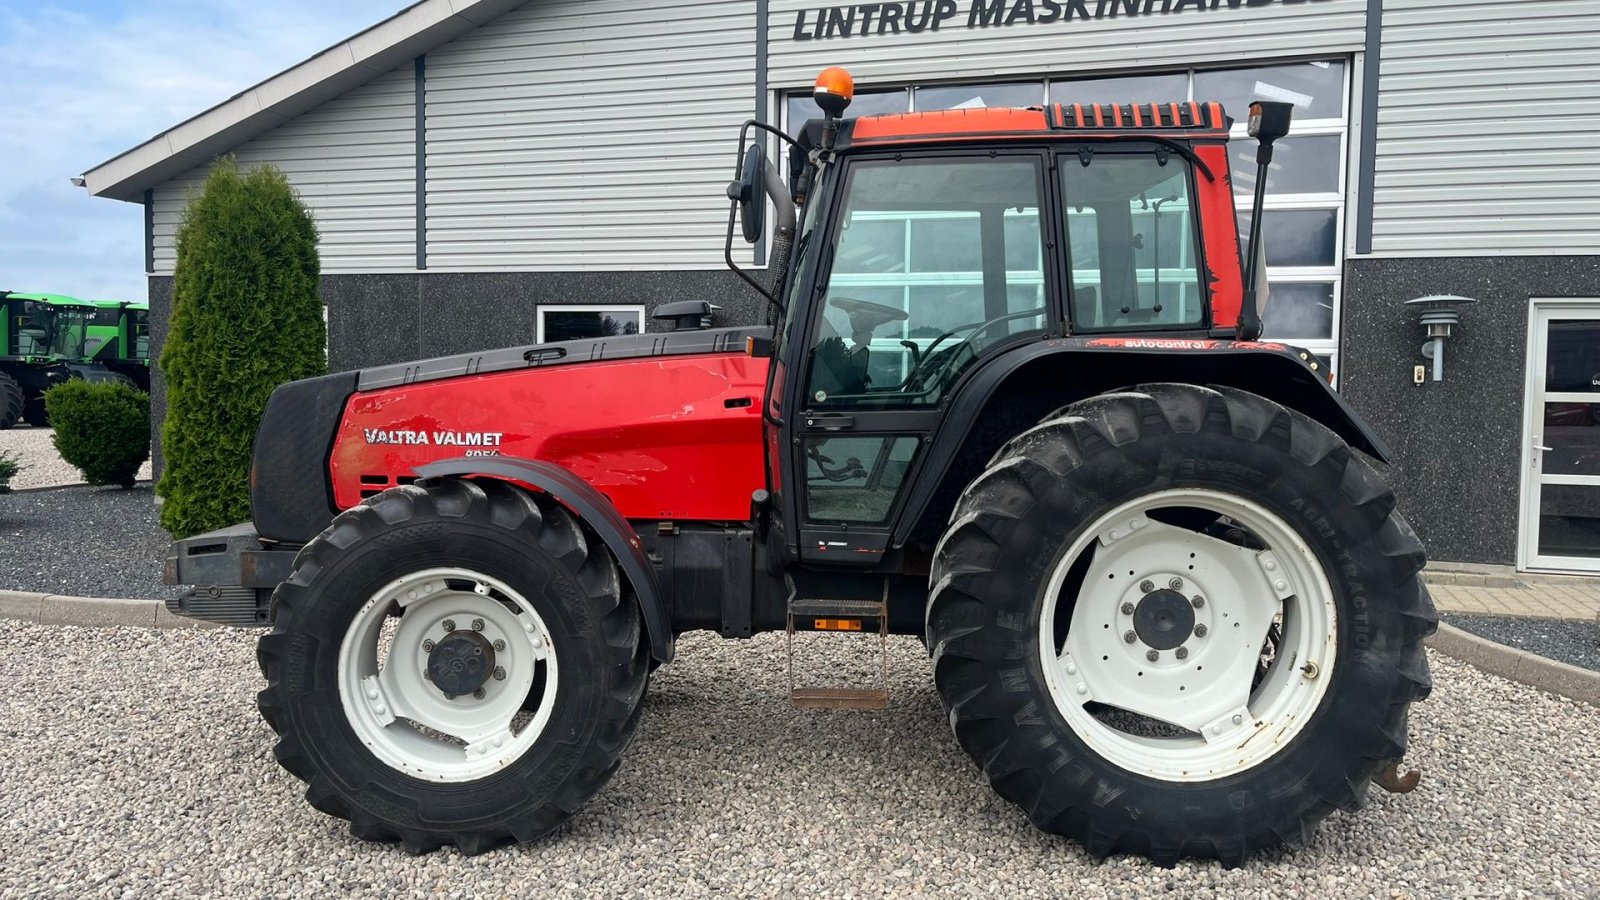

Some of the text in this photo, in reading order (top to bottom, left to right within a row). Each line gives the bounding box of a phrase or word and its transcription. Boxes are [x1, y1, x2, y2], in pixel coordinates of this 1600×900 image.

[794, 0, 957, 40] LINTRUP
[1124, 339, 1206, 350] autocontrol
[364, 428, 503, 447] VALTRA VALMET
